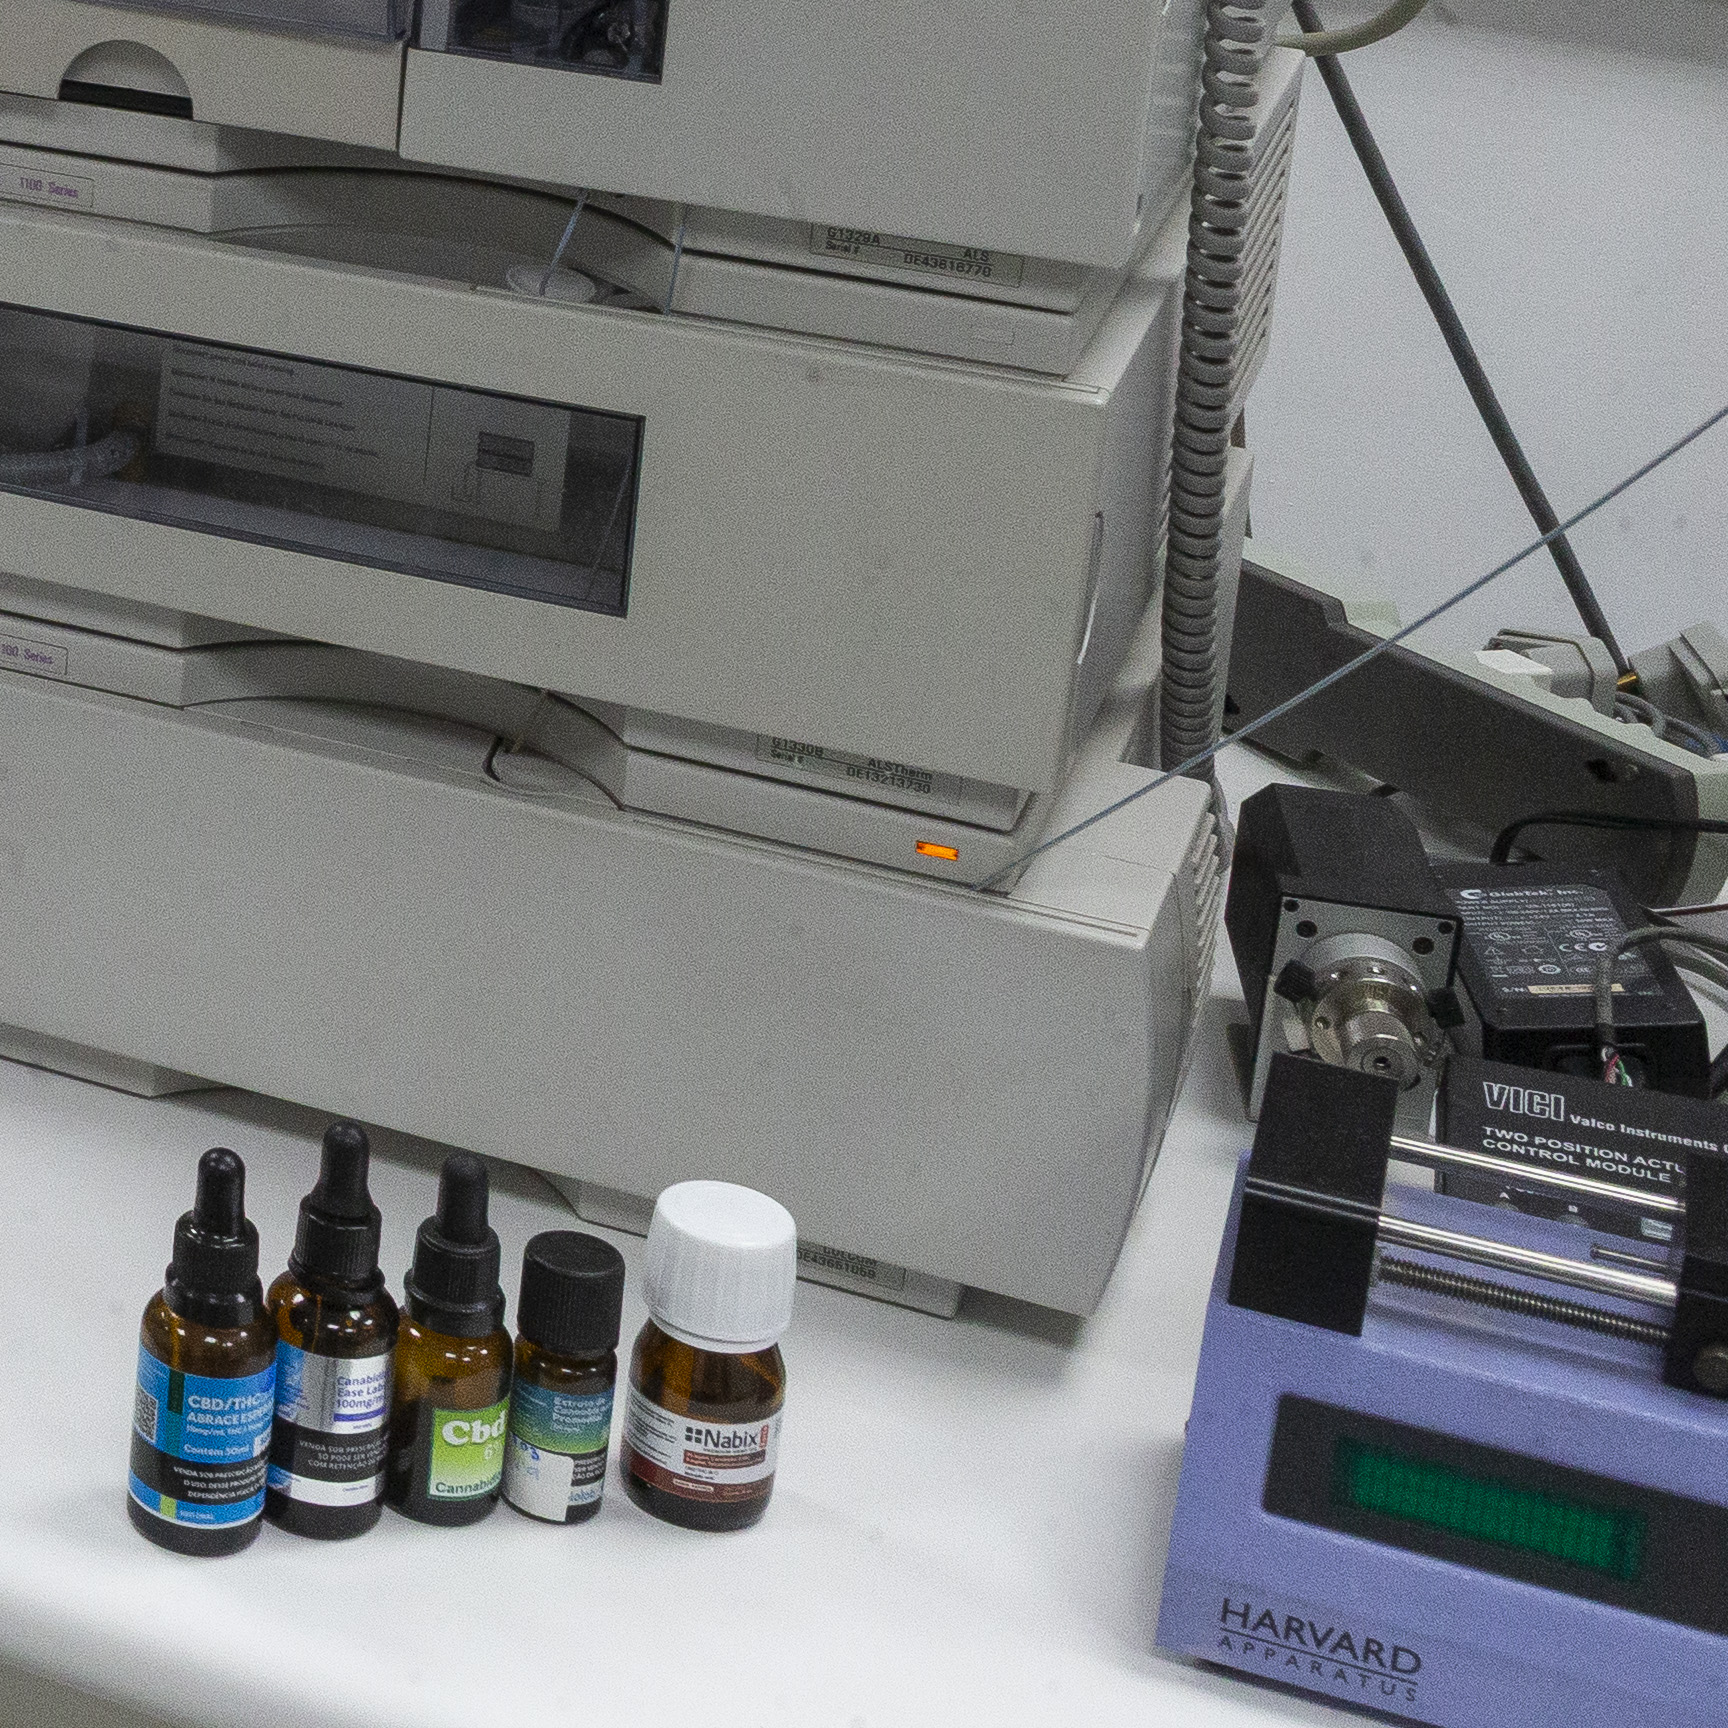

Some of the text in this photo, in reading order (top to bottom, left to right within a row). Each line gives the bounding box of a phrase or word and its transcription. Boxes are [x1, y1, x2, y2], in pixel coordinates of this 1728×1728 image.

[19, 176, 42, 192] 1100
[48, 180, 78, 198] Series
[964, 247, 990, 263] ALS
[24, 646, 53, 666] Series
[867, 757, 933, 781] ALSTherm
[1482, 1080, 1565, 1122] VICI
[1482, 1125, 1528, 1144] TWO
[1534, 1136, 1628, 1163] POSITION
[1570, 1113, 1718, 1153] Valco Instruments
[1482, 1138, 1672, 1183] CONTROL MODULE
[337, 1387, 364, 1398] Ease
[442, 1409, 506, 1446] Cbd
[704, 1428, 758, 1450] Nabix
[1220, 1597, 1422, 1674] HARVARD
[1218, 1635, 1417, 1703] APPARATUS
